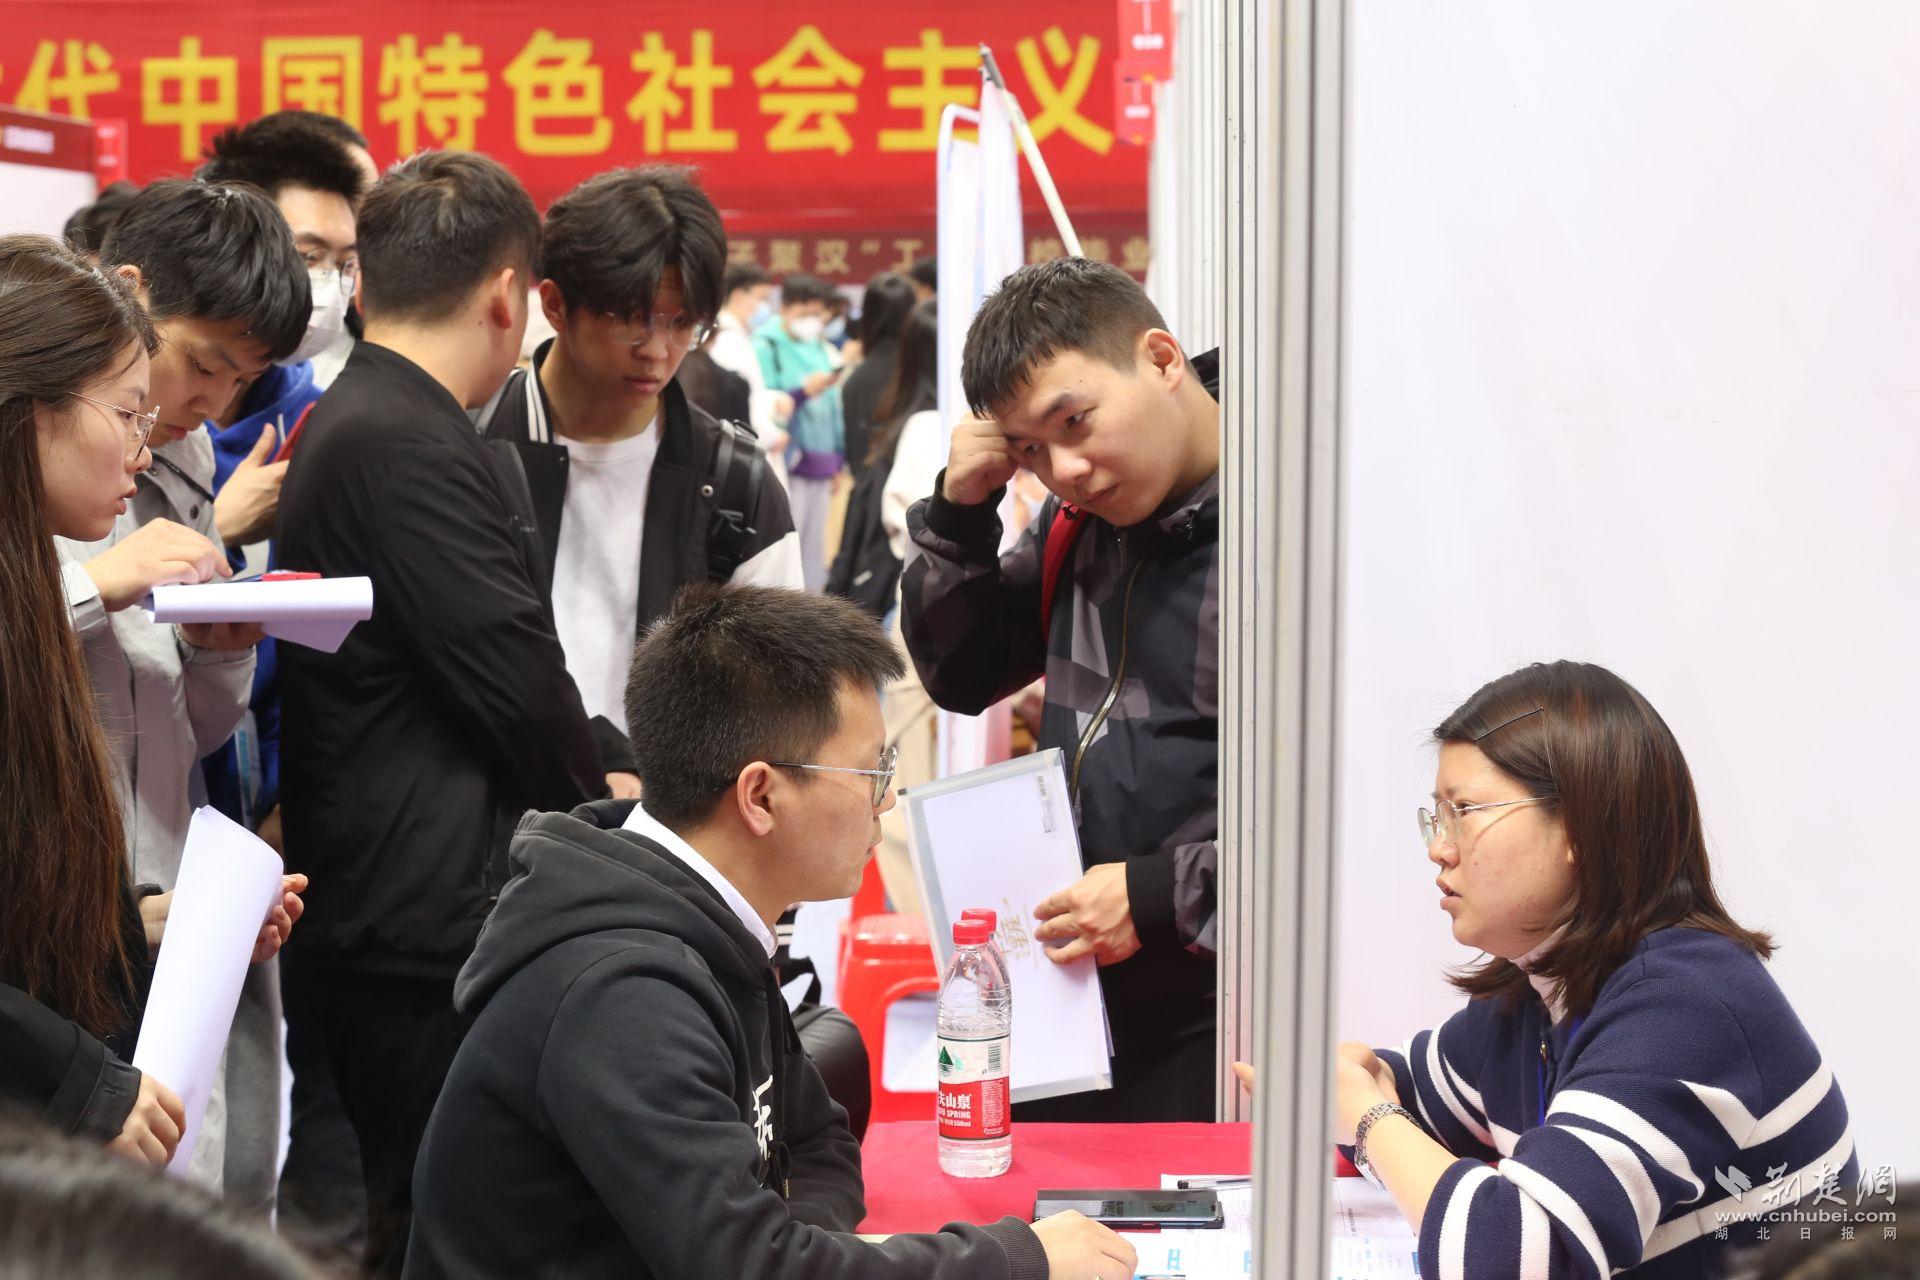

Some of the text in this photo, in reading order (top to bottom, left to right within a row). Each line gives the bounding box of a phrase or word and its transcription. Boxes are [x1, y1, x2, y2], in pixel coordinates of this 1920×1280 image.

[0, 25, 1114, 162] 代中国特色社会主义
[947, 1110, 971, 1118] SPRING
